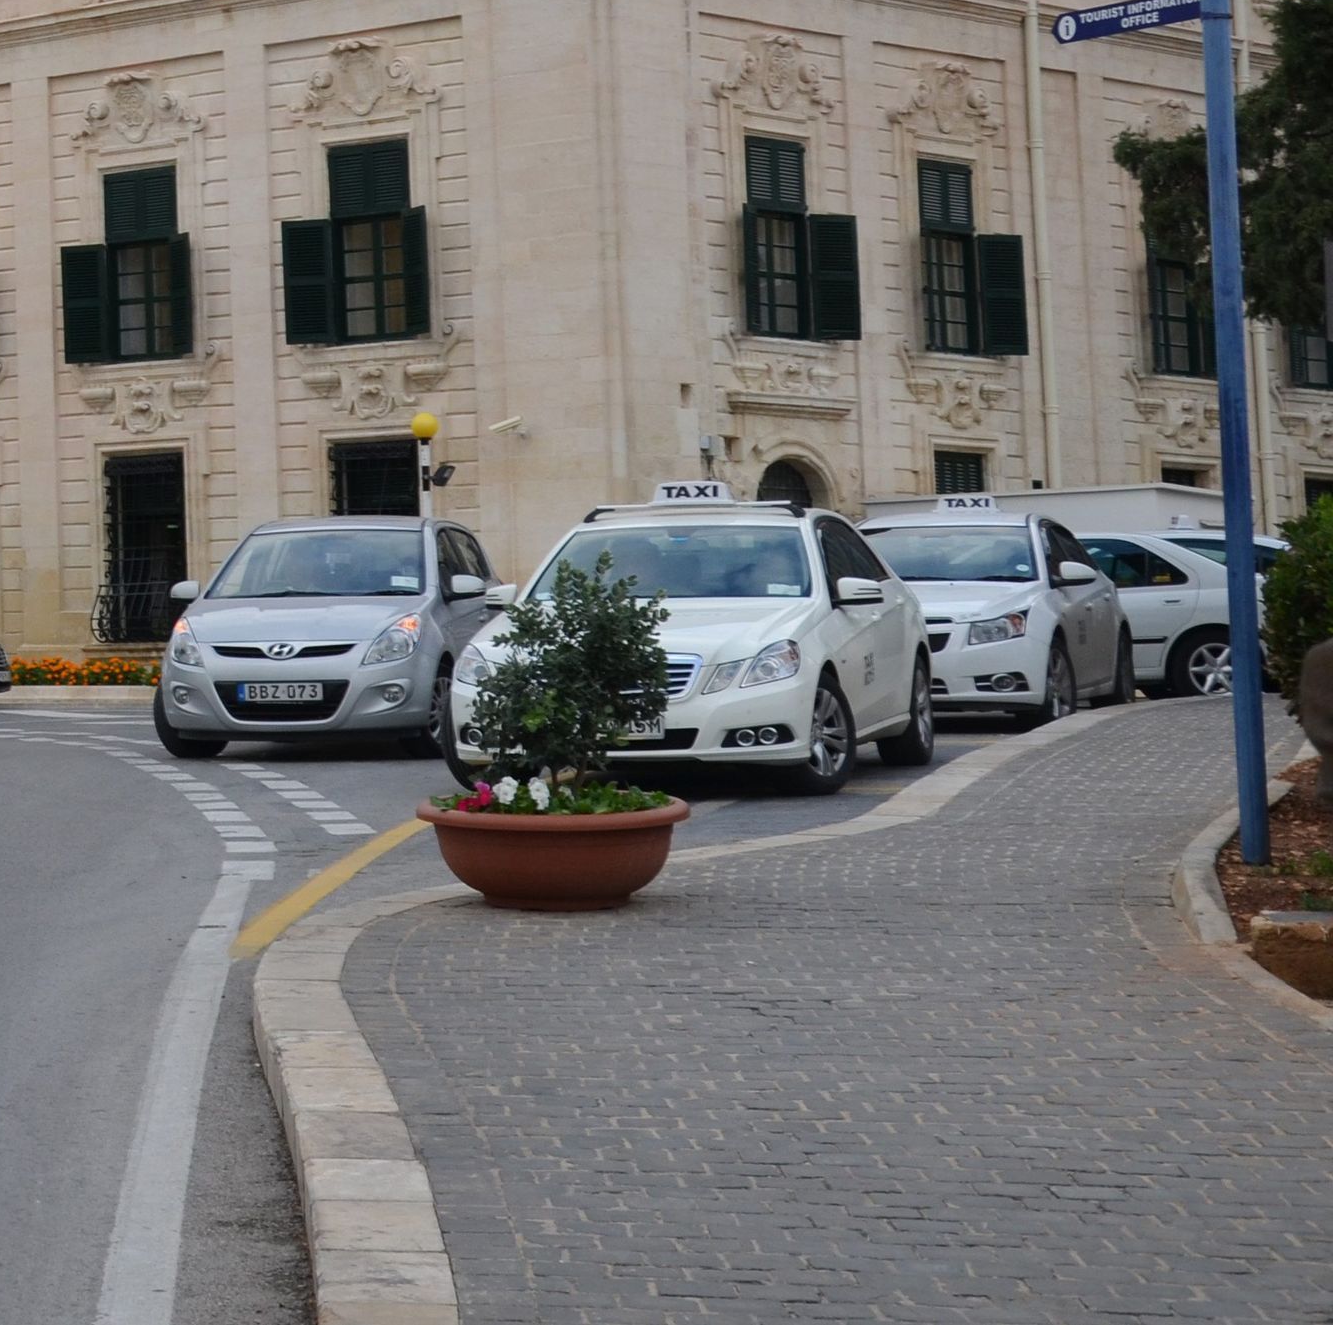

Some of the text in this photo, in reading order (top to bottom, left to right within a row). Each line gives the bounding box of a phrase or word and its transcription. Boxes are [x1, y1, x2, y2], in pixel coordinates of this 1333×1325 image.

[1079, 5, 1125, 24] TOURIST
[1120, 11, 1160, 28] OFFICE
[661, 484, 719, 499] TAXI
[943, 498, 991, 508] TAXI
[248, 685, 318, 699] BBZ 073
